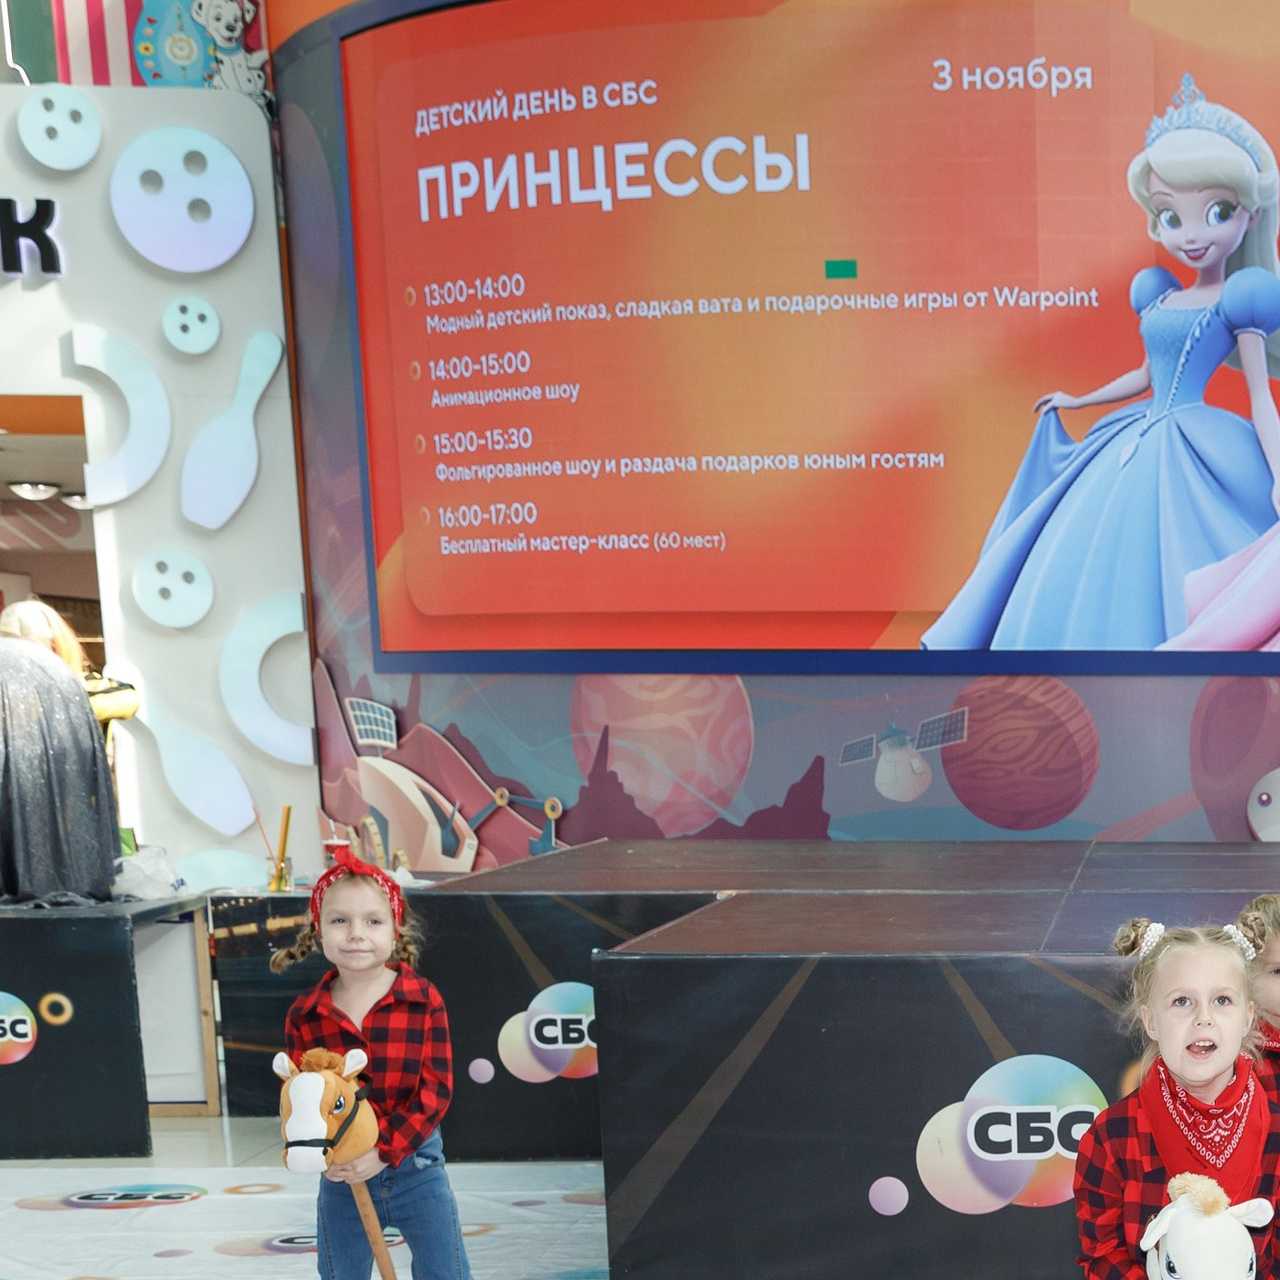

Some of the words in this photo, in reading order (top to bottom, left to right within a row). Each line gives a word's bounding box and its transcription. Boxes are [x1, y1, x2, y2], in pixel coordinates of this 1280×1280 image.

[932, 58, 953, 92] 3
[962, 56, 1093, 98] ноября
[414, 89, 509, 137] ДЕТСКИЙ
[512, 87, 577, 121] ДЕНЬ
[582, 84, 598, 109] В
[602, 79, 658, 107] СБС
[417, 132, 811, 222] ПРИНЦЕССЫ
[424, 273, 526, 306] 13:00-14:00
[426, 309, 485, 335] Модный
[487, 303, 552, 330] детский
[555, 301, 612, 322] показ,
[615, 299, 694, 319] сладкая
[699, 296, 743, 315] вата
[747, 297, 760, 312] и
[765, 292, 899, 316] подарочные
[904, 289, 958, 313] игры
[963, 288, 989, 307] от
[993, 285, 1099, 312] Warpoint
[429, 350, 531, 381] 14:00-15:00
[431, 384, 543, 409] Анимационное
[545, 383, 580, 403] шоу
[433, 427, 533, 455] 15:00-15:30
[435, 460, 563, 483] Фольгированное
[565, 458, 602, 479] шоу
[605, 459, 616, 474] и
[620, 456, 698, 478] раздача
[701, 453, 800, 474] подарков
[803, 452, 866, 470] юным
[871, 452, 945, 468] гостям
[438, 502, 538, 528] 16:00-17:00
[440, 533, 528, 555] Бесплатный
[530, 533, 650, 554] мастер-класс
[974, 1111, 1095, 1154] СБС
